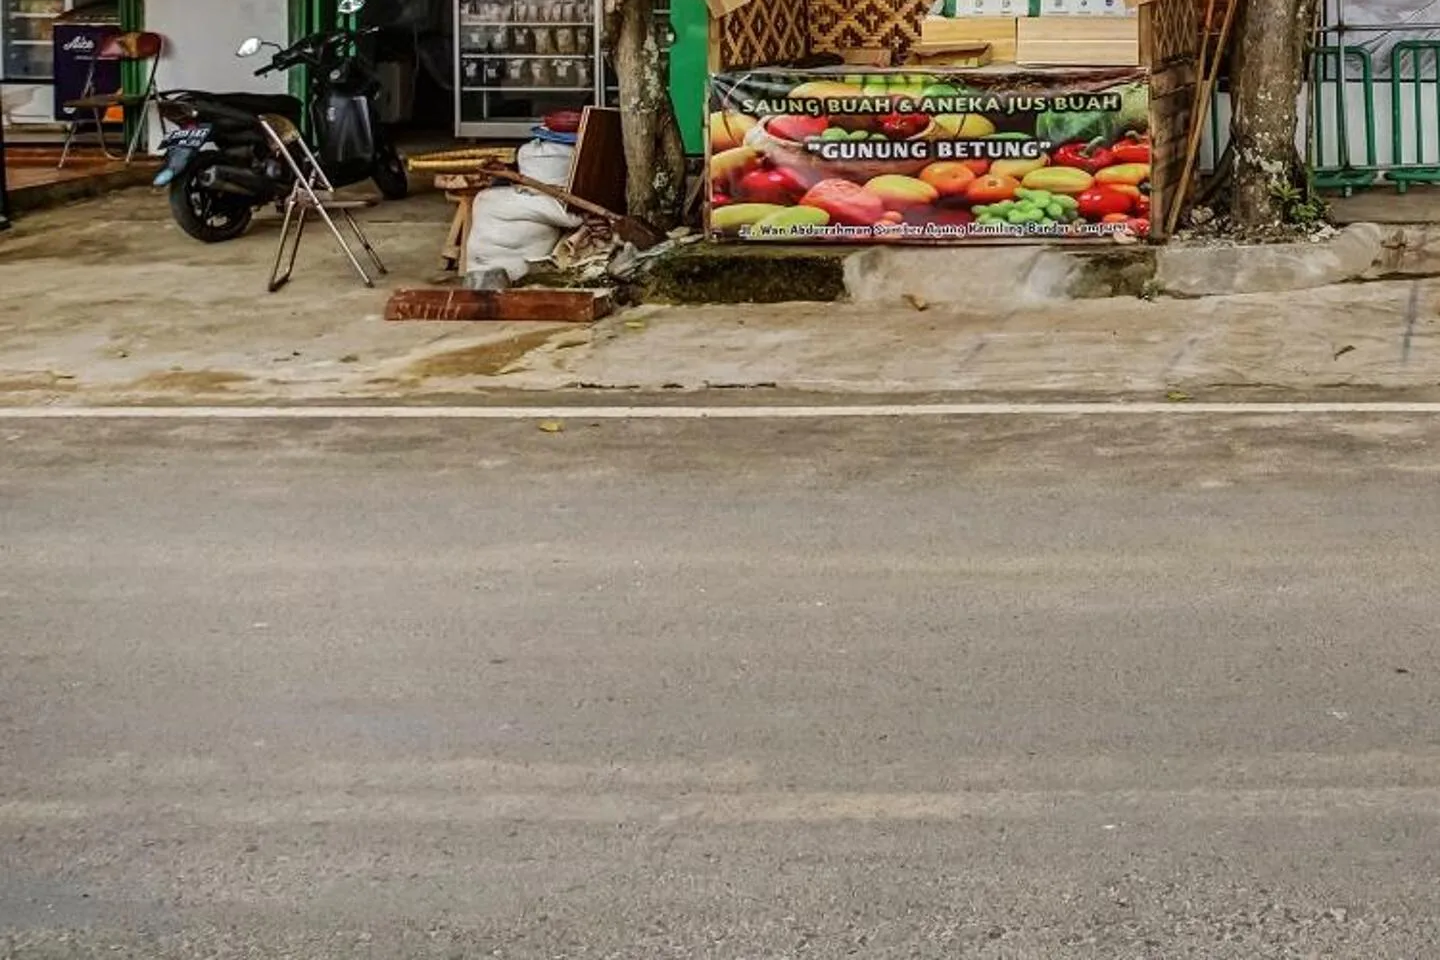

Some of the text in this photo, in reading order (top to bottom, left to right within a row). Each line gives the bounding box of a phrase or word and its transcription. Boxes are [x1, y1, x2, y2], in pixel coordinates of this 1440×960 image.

[742, 95, 1120, 116] SAUNG BUAH & ANEKA JUS BUAH
[760, 225, 785, 236] Wan
[1027, 222, 1071, 235] Bandar
